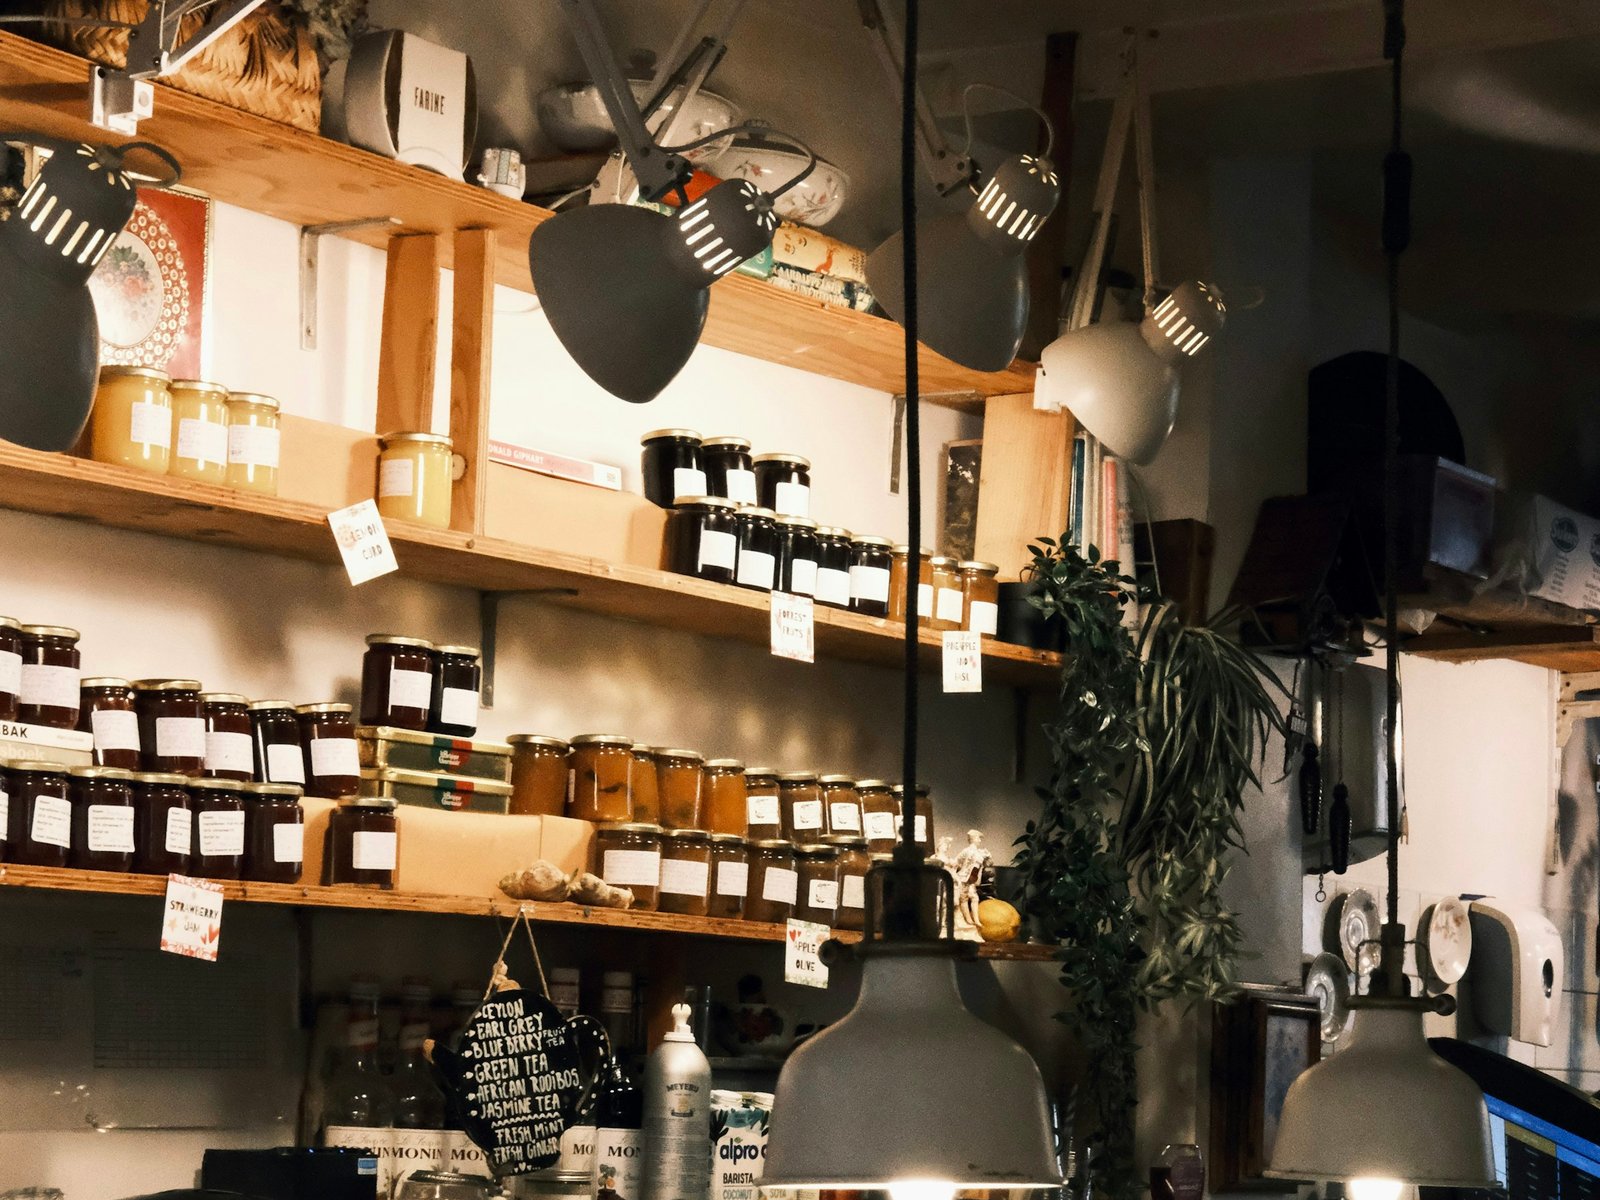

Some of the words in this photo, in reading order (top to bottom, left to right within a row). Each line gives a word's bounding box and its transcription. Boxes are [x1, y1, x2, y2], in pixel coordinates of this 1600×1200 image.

[414, 87, 446, 115] FARINE
[363, 544, 383, 560] CURD
[0, 724, 28, 738] BAK
[170, 900, 219, 919] STRAWBERRY
[184, 921, 201, 933] JAM
[795, 941, 816, 954] APPLE
[796, 959, 815, 972] OLIVE
[482, 998, 524, 1020] CEYLON
[477, 1020, 507, 1040] EARL
[508, 1012, 543, 1035] GREY
[546, 1036, 565, 1048] TEA
[474, 1058, 519, 1083] GREEN
[523, 1052, 549, 1076] TEA
[535, 1093, 561, 1112] TEA
[494, 1125, 533, 1145] FRESH
[493, 1145, 523, 1164] FRESH
[720, 1138, 759, 1166] alpro
[723, 1173, 754, 1184] BARISTA
[723, 1189, 753, 1200] COCONUT
